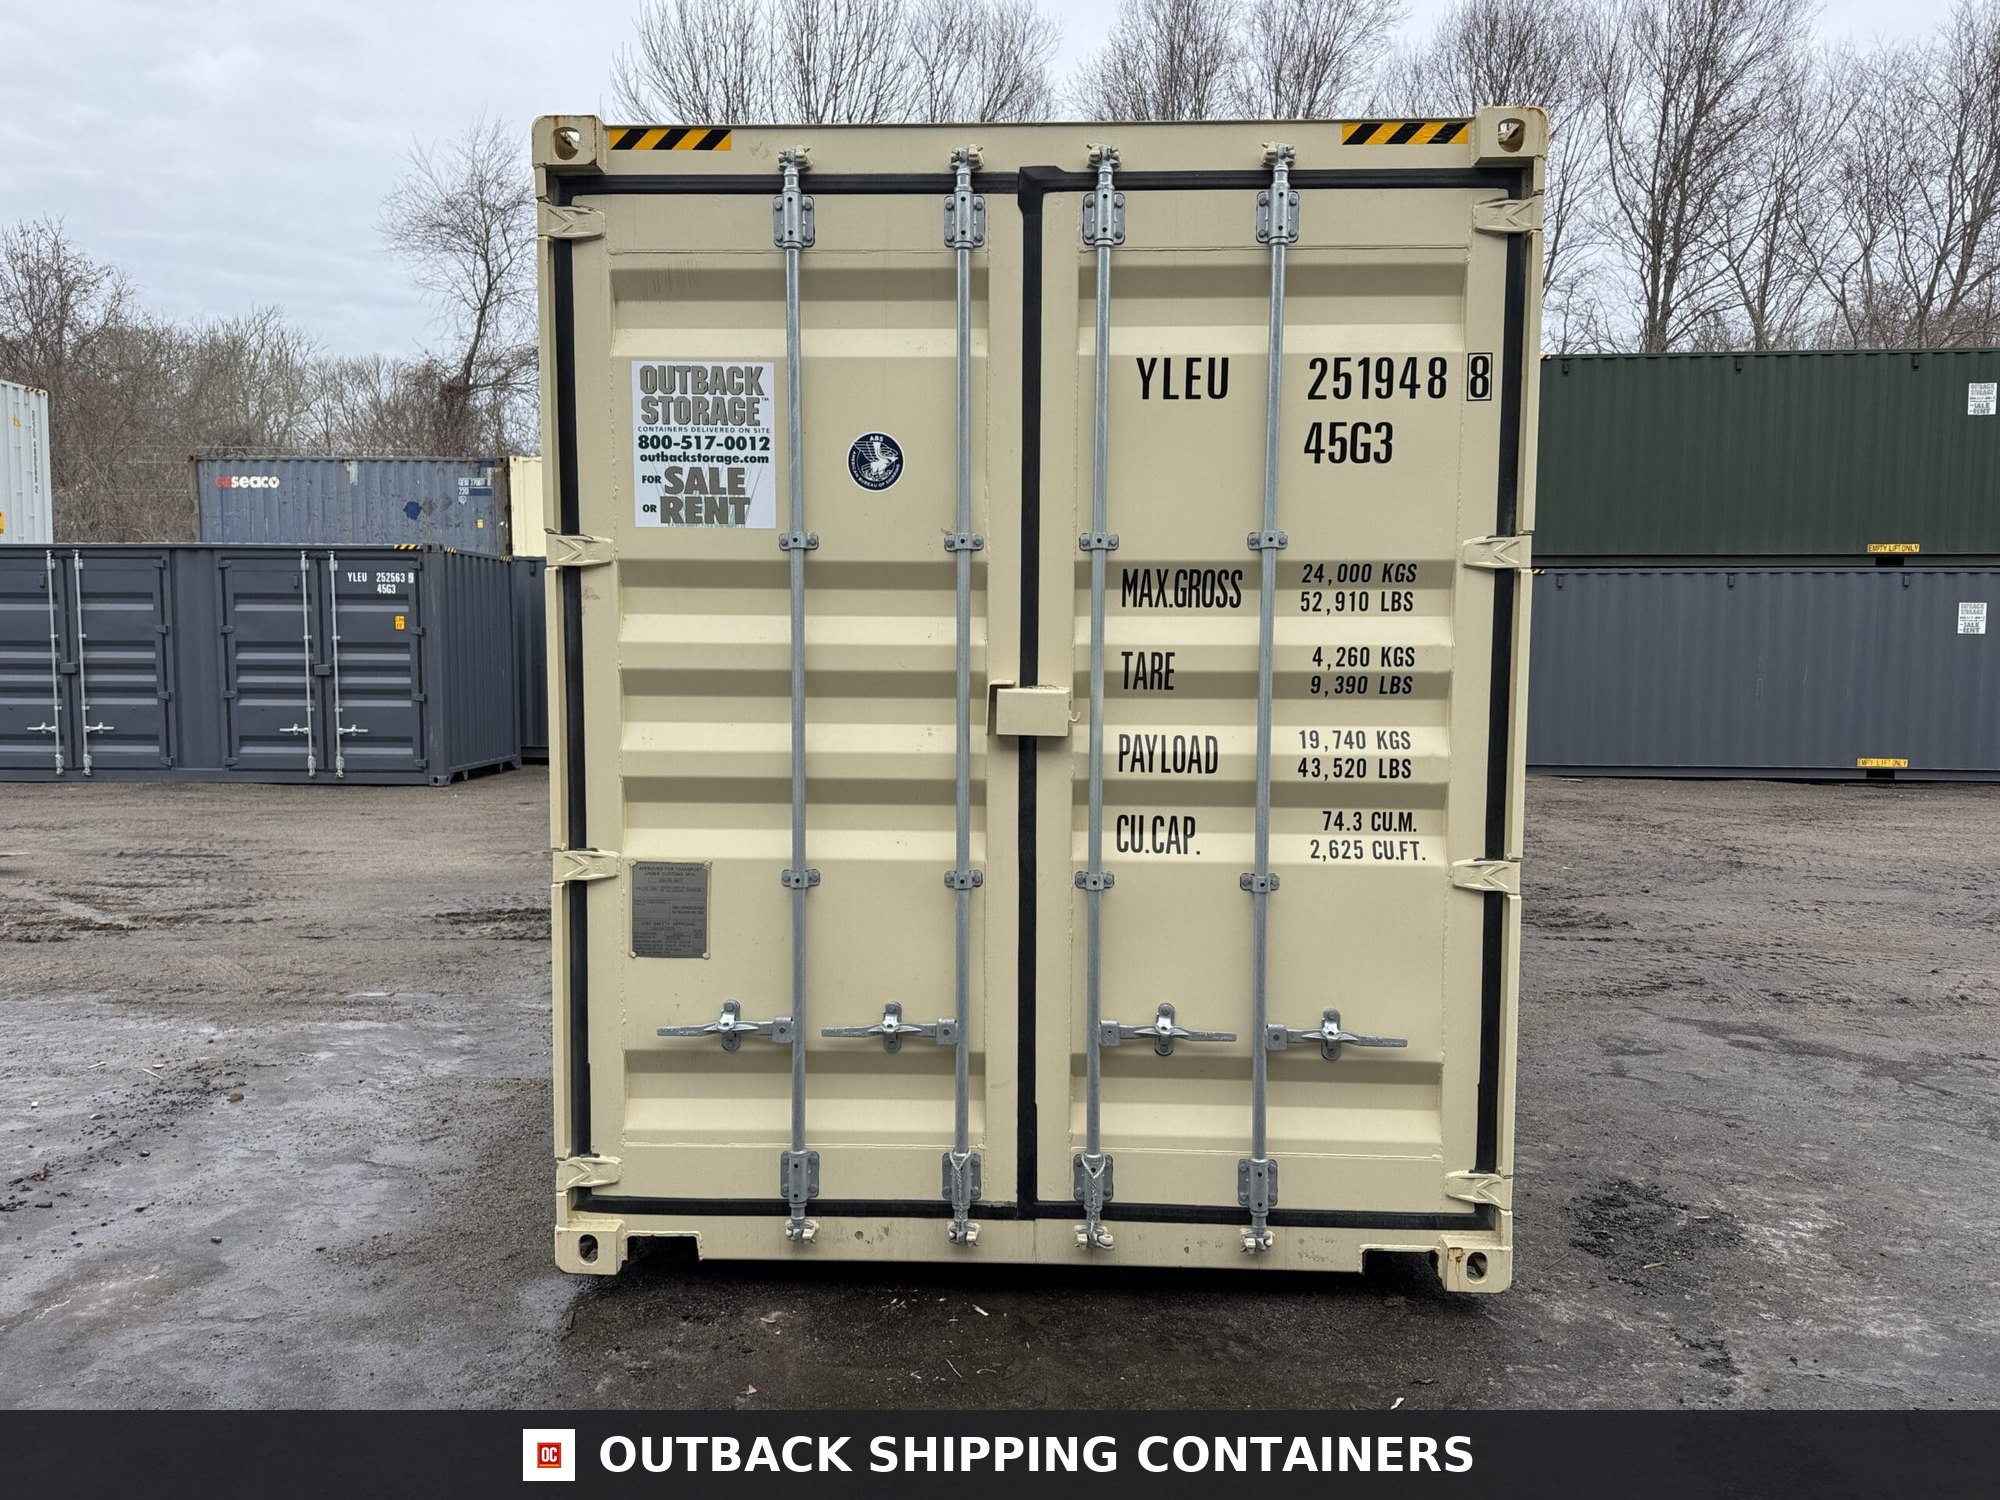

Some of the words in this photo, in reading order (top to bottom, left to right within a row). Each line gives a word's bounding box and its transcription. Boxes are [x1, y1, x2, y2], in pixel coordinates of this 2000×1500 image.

[640, 365, 764, 396] OUTBACK
[1136, 357, 1229, 400] YLEU
[1308, 357, 1447, 400] 251948
[1468, 354, 1491, 400] 8
[641, 396, 760, 426] STORAGE
[638, 435, 770, 451] 800-517-0012
[1304, 422, 1393, 464] 45G3
[640, 452, 769, 464] outbackstorage.com
[642, 475, 661, 484] FOR
[664, 466, 745, 495] SALE
[643, 504, 657, 513] OR
[660, 496, 750, 524] RENT
[347, 572, 368, 582] YLEU
[376, 572, 406, 582] 252563
[377, 584, 396, 594] 45G3
[1121, 568, 1242, 608] MAX.GROSS
[1302, 563, 1372, 586] 24,000
[1382, 564, 1417, 583] KGS
[1300, 591, 1369, 615] 52,910
[1381, 591, 1414, 612] LBS
[1121, 652, 1175, 690] TARE
[1312, 647, 1370, 670] 4,260
[1381, 647, 1415, 667] KGS
[1310, 676, 1367, 697] 9,390
[1379, 676, 1412, 694] LBS
[1118, 734, 1218, 774] PAYLOAD
[1299, 730, 1366, 750] 19,740
[1377, 730, 1411, 749] KGS
[1298, 758, 1366, 781] 43,520
[1379, 758, 1411, 778] LBS
[1117, 814, 1201, 855] CU.CAP.
[1323, 811, 1362, 831] 74.3
[1371, 811, 1417, 832] CU.M.
[1310, 839, 1363, 861] 2,625
[1372, 840, 1426, 860] CU.FT.
